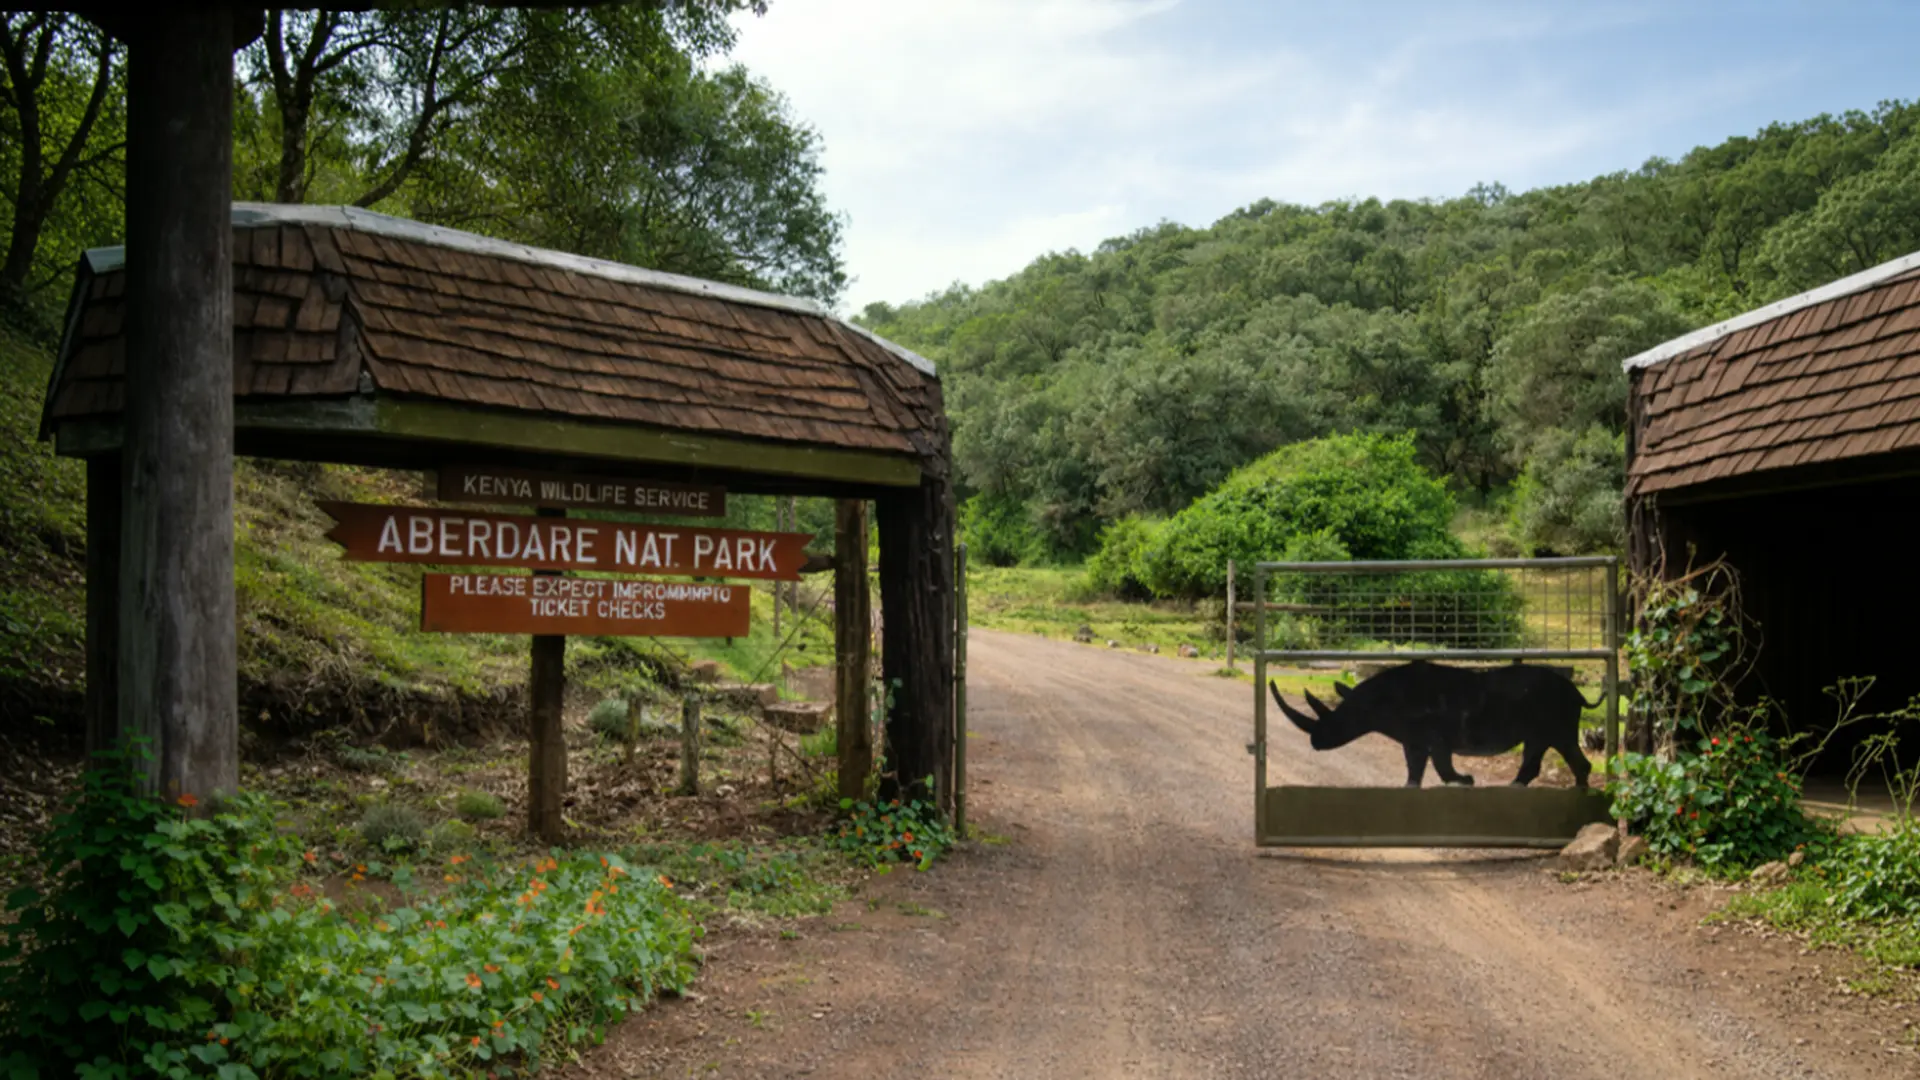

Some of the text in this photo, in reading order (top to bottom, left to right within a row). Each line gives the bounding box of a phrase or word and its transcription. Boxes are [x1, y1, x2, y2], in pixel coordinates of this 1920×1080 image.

[463, 475, 709, 509] KENYA WILDLIFE SERVICE
[377, 516, 778, 572] ABERDARE NAT. PARK
[450, 575, 526, 596] PLEASE
[532, 578, 606, 598] EXPECT
[529, 598, 666, 620] TICKET CHECKS
